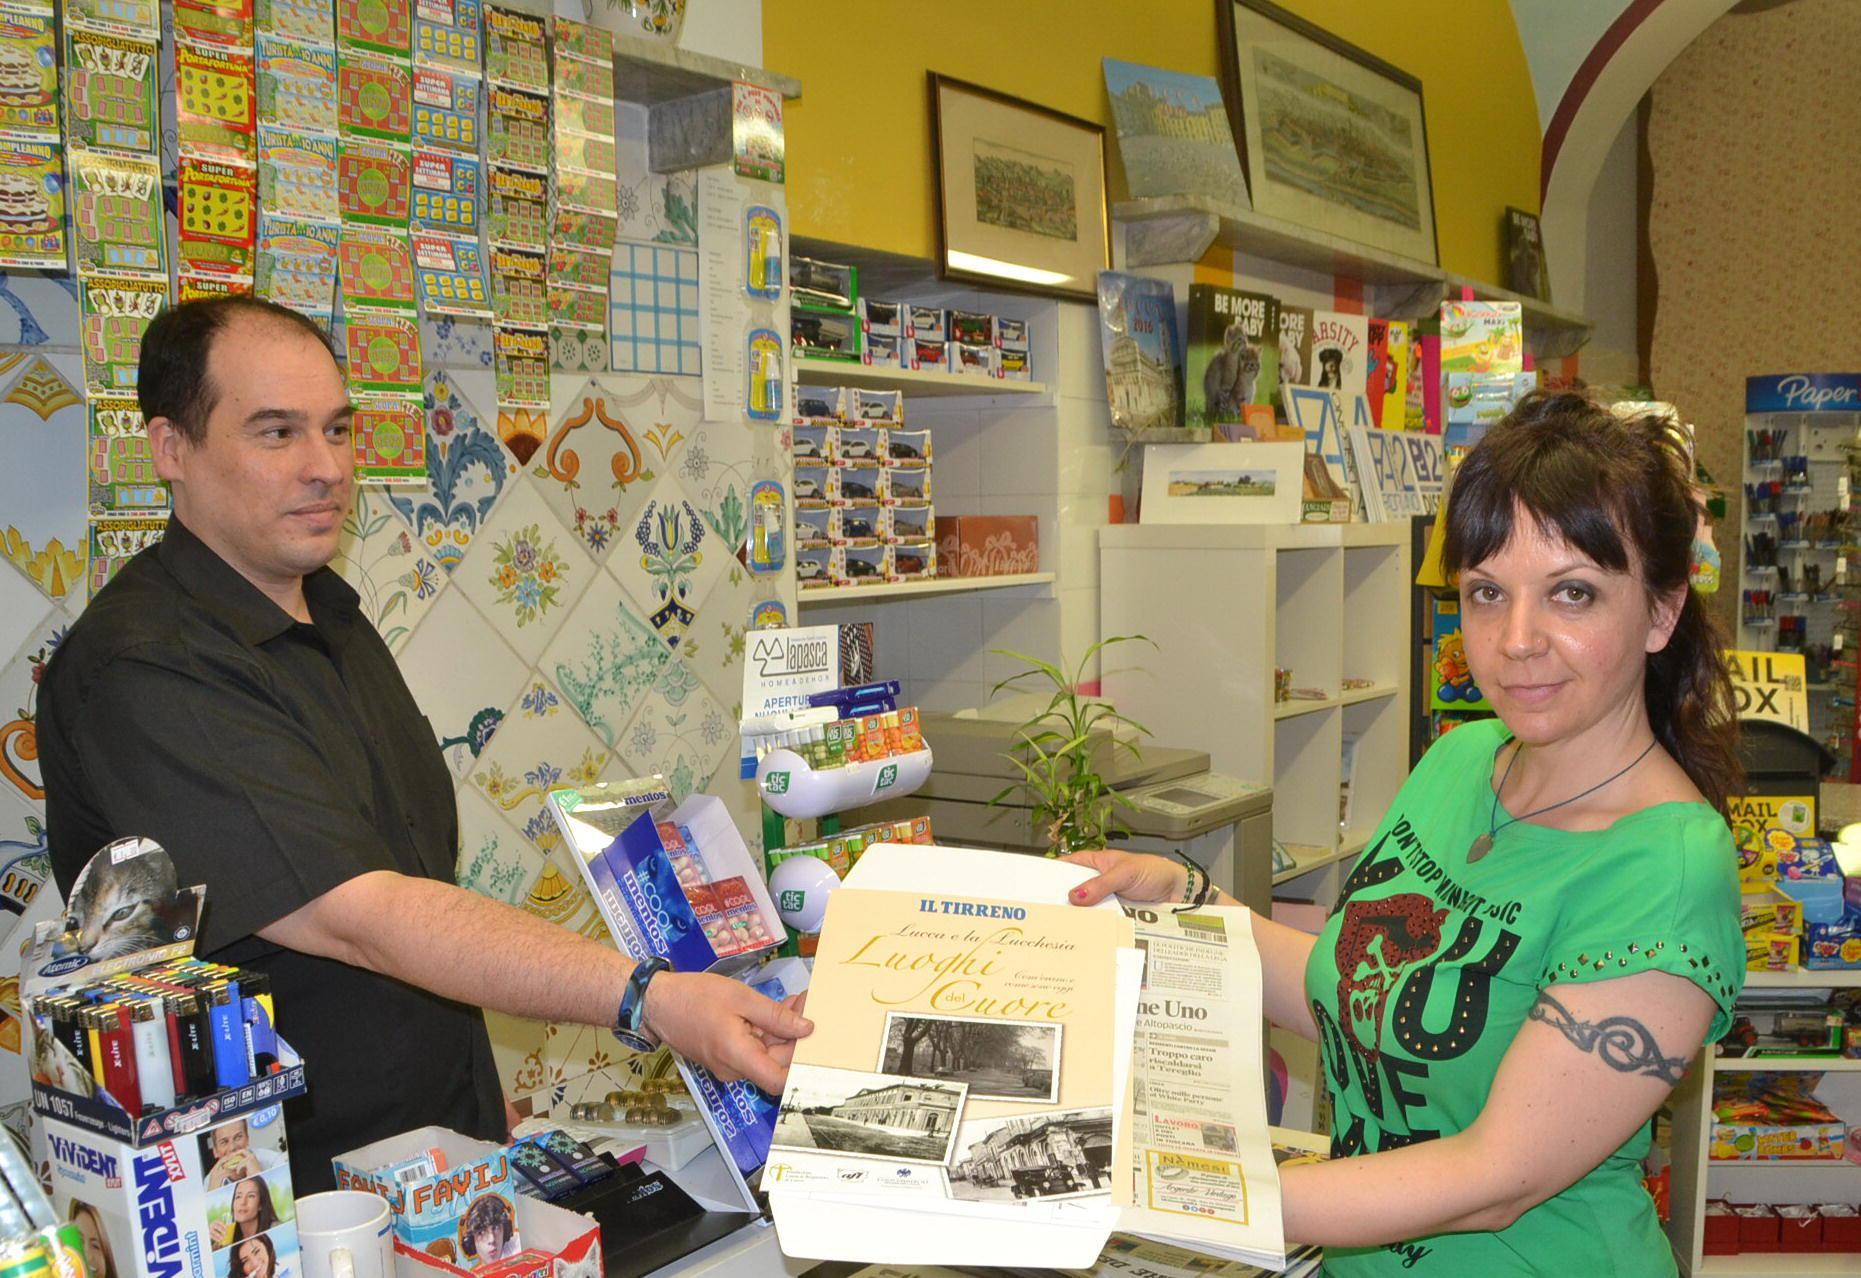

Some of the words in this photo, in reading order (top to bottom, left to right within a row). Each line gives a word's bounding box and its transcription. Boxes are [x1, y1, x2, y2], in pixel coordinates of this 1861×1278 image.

[180, 48, 249, 72] PORTAFORTUNA
[195, 47, 229, 61] SUPER
[420, 76, 447, 88] SUPER
[201, 164, 234, 176] SUPER
[419, 160, 447, 171] SUPER
[183, 167, 251, 188] PORTAFORTUNA
[419, 243, 447, 253] SUPER
[196, 281, 229, 292] SUPER
[1214, 294, 1229, 313] BE
[1231, 298, 1266, 318] MORE
[1279, 313, 1305, 329] ORE
[1312, 321, 1360, 352] ARSITY
[1777, 375, 1858, 410] Paper
[786, 637, 828, 672] lapasca
[1727, 655, 1780, 684] AIL
[1735, 686, 1779, 715] OX
[771, 773, 785, 783] tic
[879, 776, 894, 787] tac
[883, 766, 895, 779] tic
[768, 782, 785, 792] tac
[624, 791, 667, 806] mentos
[637, 868, 674, 935] #COOL
[782, 899, 800, 910] tac
[786, 891, 800, 901] tic
[623, 869, 671, 955] mentos
[726, 901, 759, 917] mentos
[919, 899, 938, 914] IL
[940, 901, 1027, 921] TIRRENO
[894, 923, 945, 940] Lucca
[965, 930, 980, 943] la
[996, 930, 1076, 951] Lucchesia
[46, 957, 82, 976] Atomic
[839, 930, 1010, 995] Luoghi
[929, 979, 1074, 1019] Cuore
[945, 992, 966, 1002] del
[1164, 999, 1208, 1021] Uno
[1143, 1019, 1193, 1032] Altopascio
[1149, 1047, 1189, 1060] Troppo
[1190, 1053, 1214, 1062] caro
[34, 1089, 50, 1111] UN
[50, 1095, 74, 1119] 1057
[159, 1142, 186, 1181] XYLIT
[338, 1168, 405, 1215] FAVIJ
[413, 1154, 508, 1215] FAVIJ
